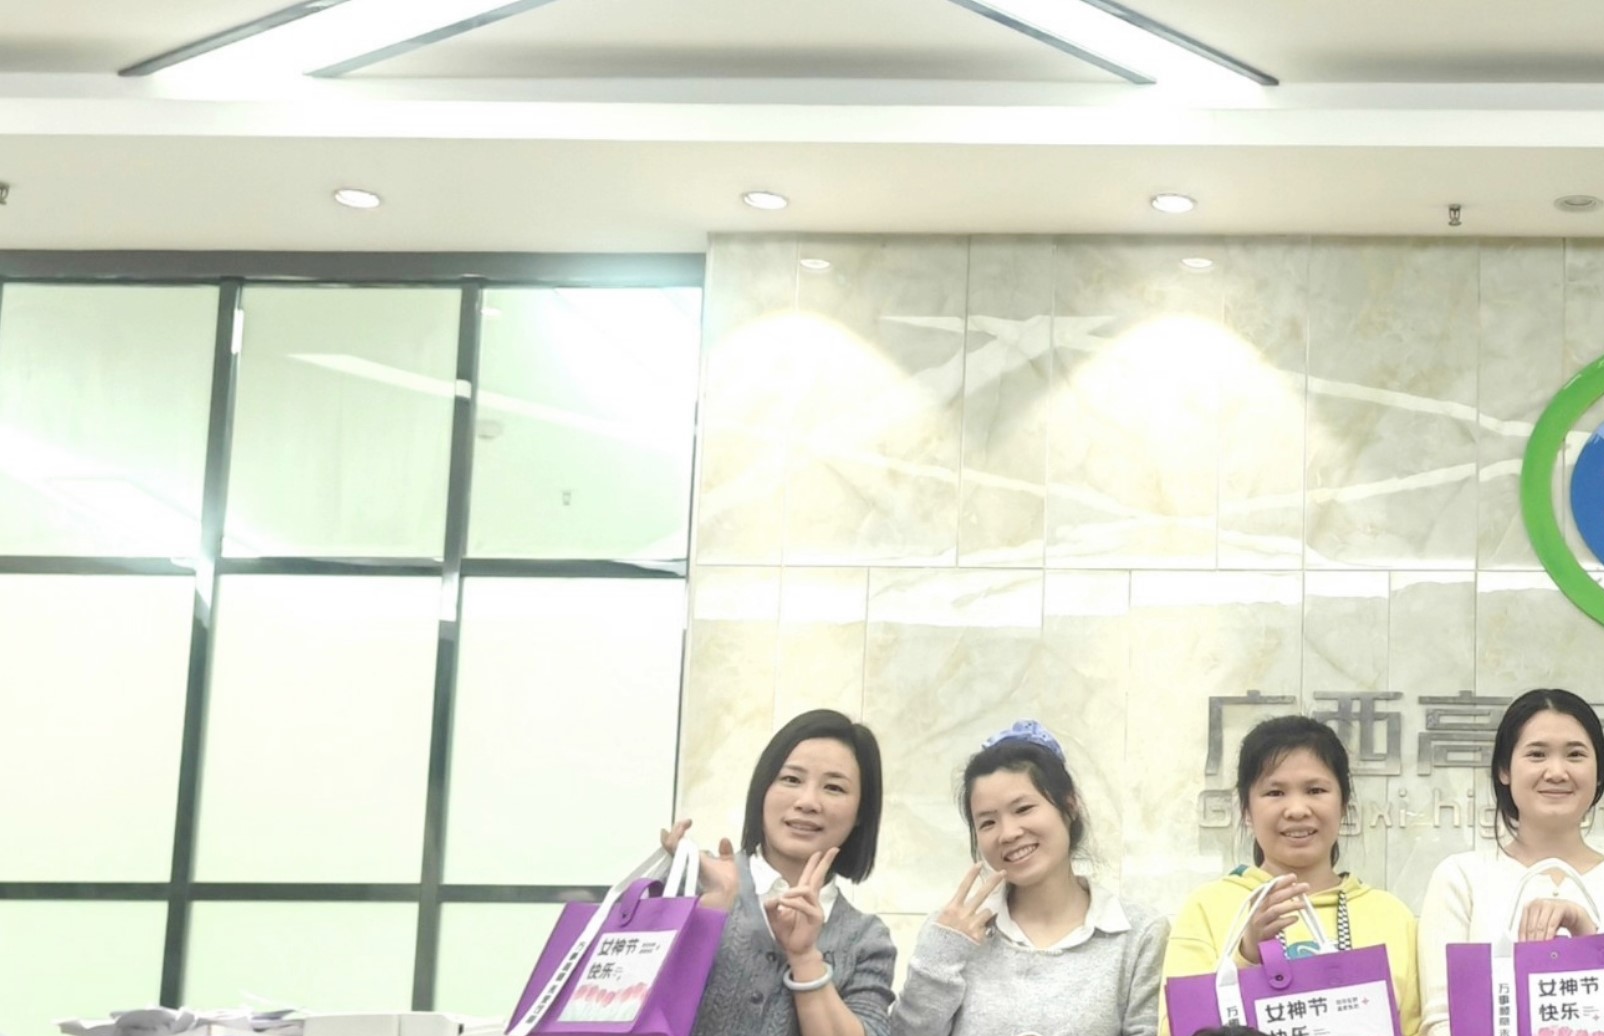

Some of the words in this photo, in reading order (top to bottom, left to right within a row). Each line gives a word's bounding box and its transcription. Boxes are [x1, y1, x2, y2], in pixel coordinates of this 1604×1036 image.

[1538, 977, 1599, 996] 女神节
[1265, 997, 1328, 1023] 女神节
[1540, 1003, 1580, 1022] 快乐
